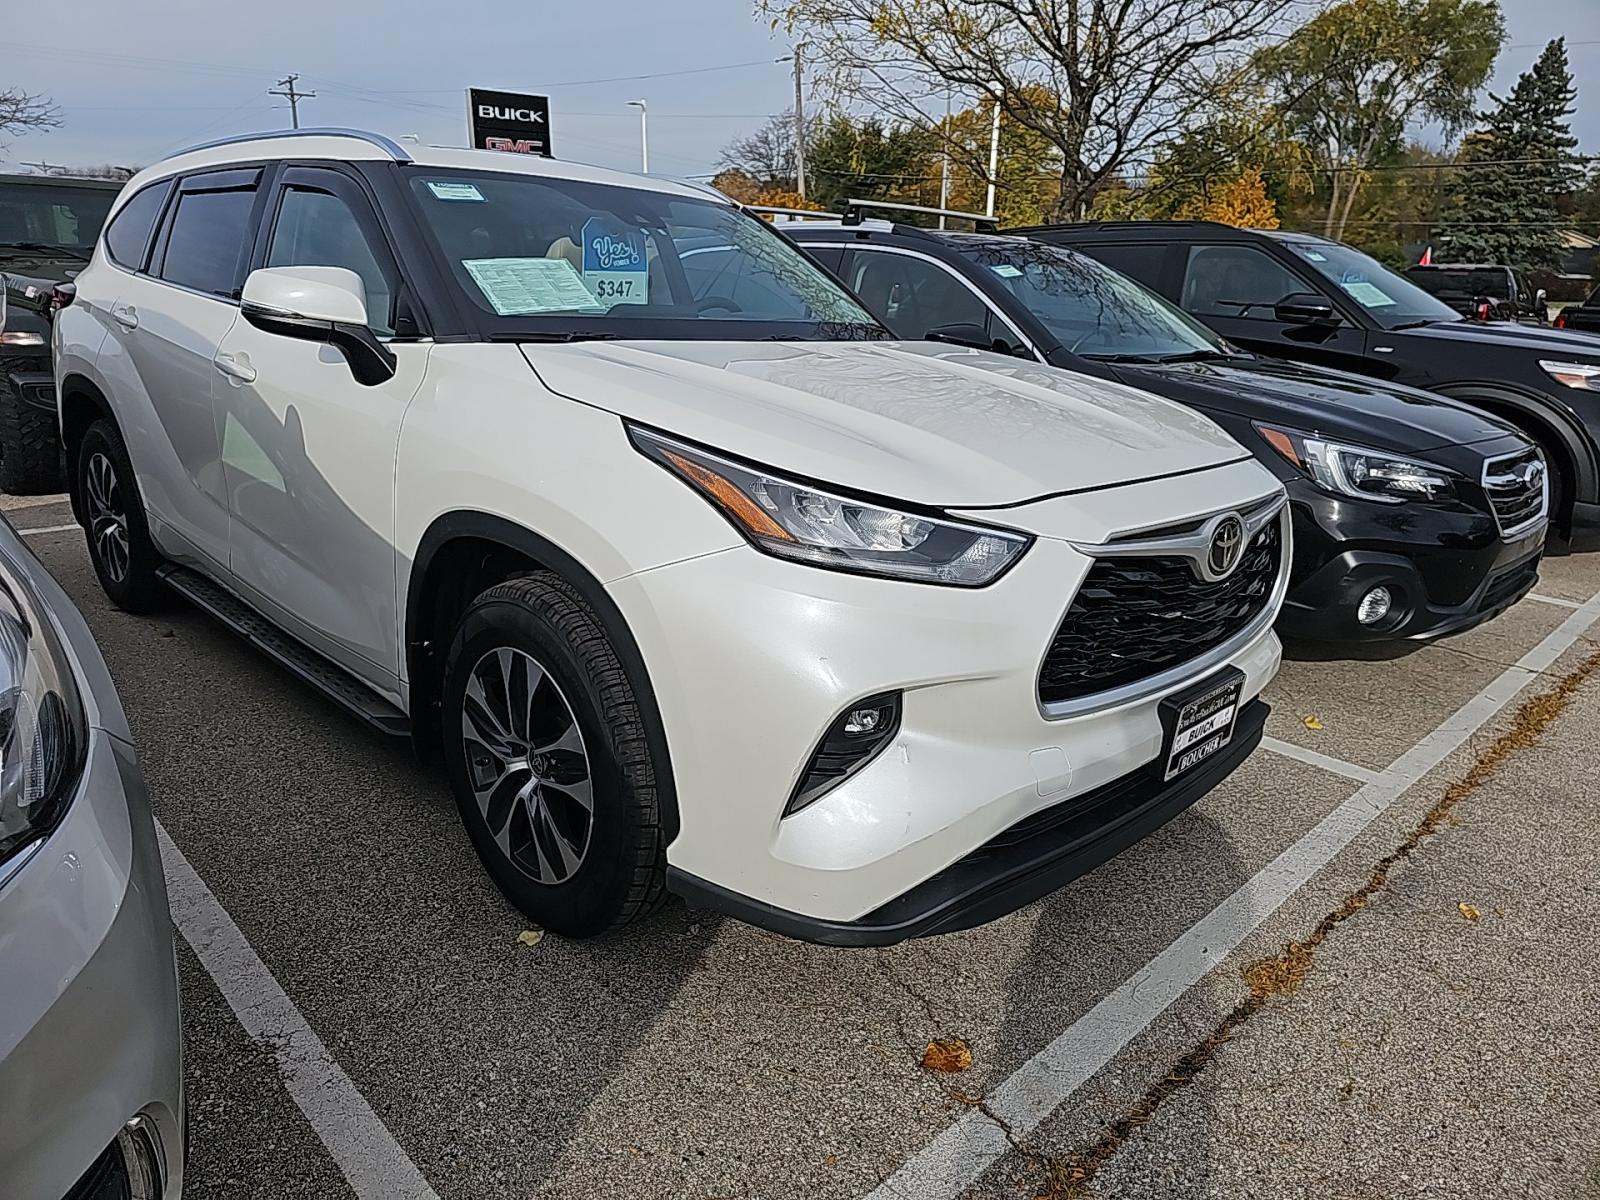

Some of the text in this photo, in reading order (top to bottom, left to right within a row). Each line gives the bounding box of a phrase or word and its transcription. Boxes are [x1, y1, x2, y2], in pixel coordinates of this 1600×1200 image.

[478, 104, 544, 123] BUICK
[485, 136, 543, 155] GMC
[597, 280, 633, 298] $347
[1187, 717, 1217, 743] BUICK
